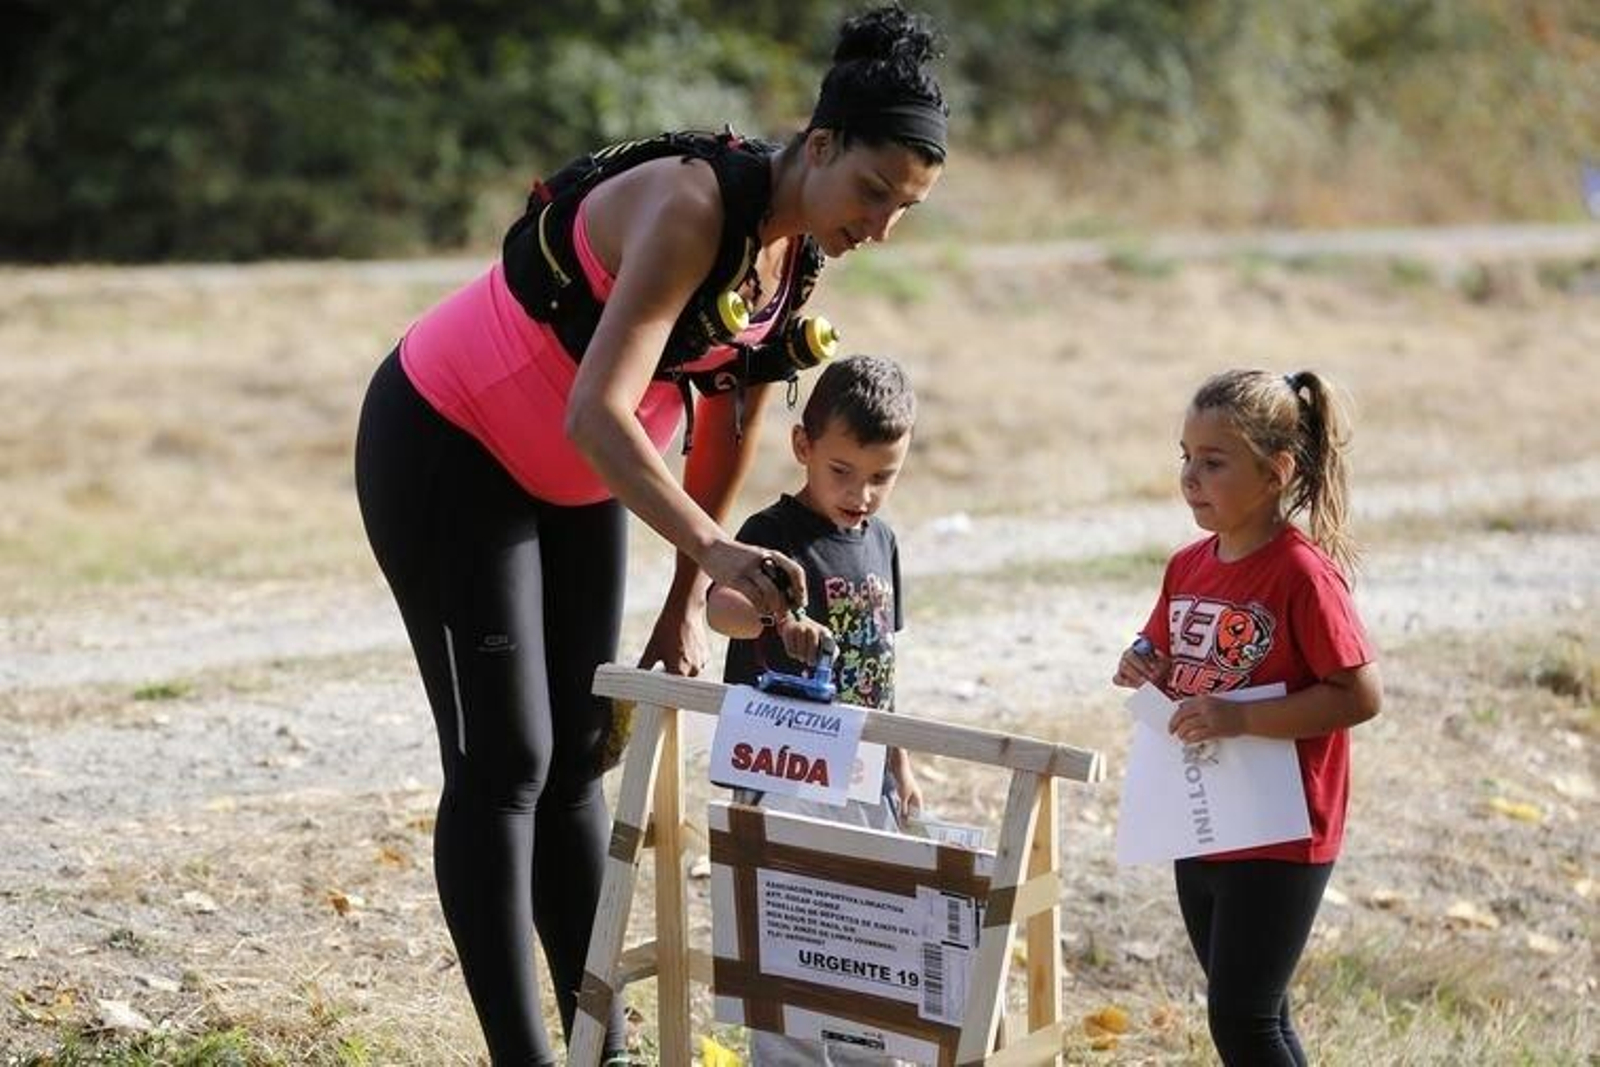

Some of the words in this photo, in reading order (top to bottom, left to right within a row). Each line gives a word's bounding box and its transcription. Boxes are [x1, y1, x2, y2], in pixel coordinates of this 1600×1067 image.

[744, 701, 842, 732] LIMIACTIVA
[731, 742, 829, 787] SAÍDA
[799, 950, 892, 981] URGENTE
[897, 971, 920, 987] 19
